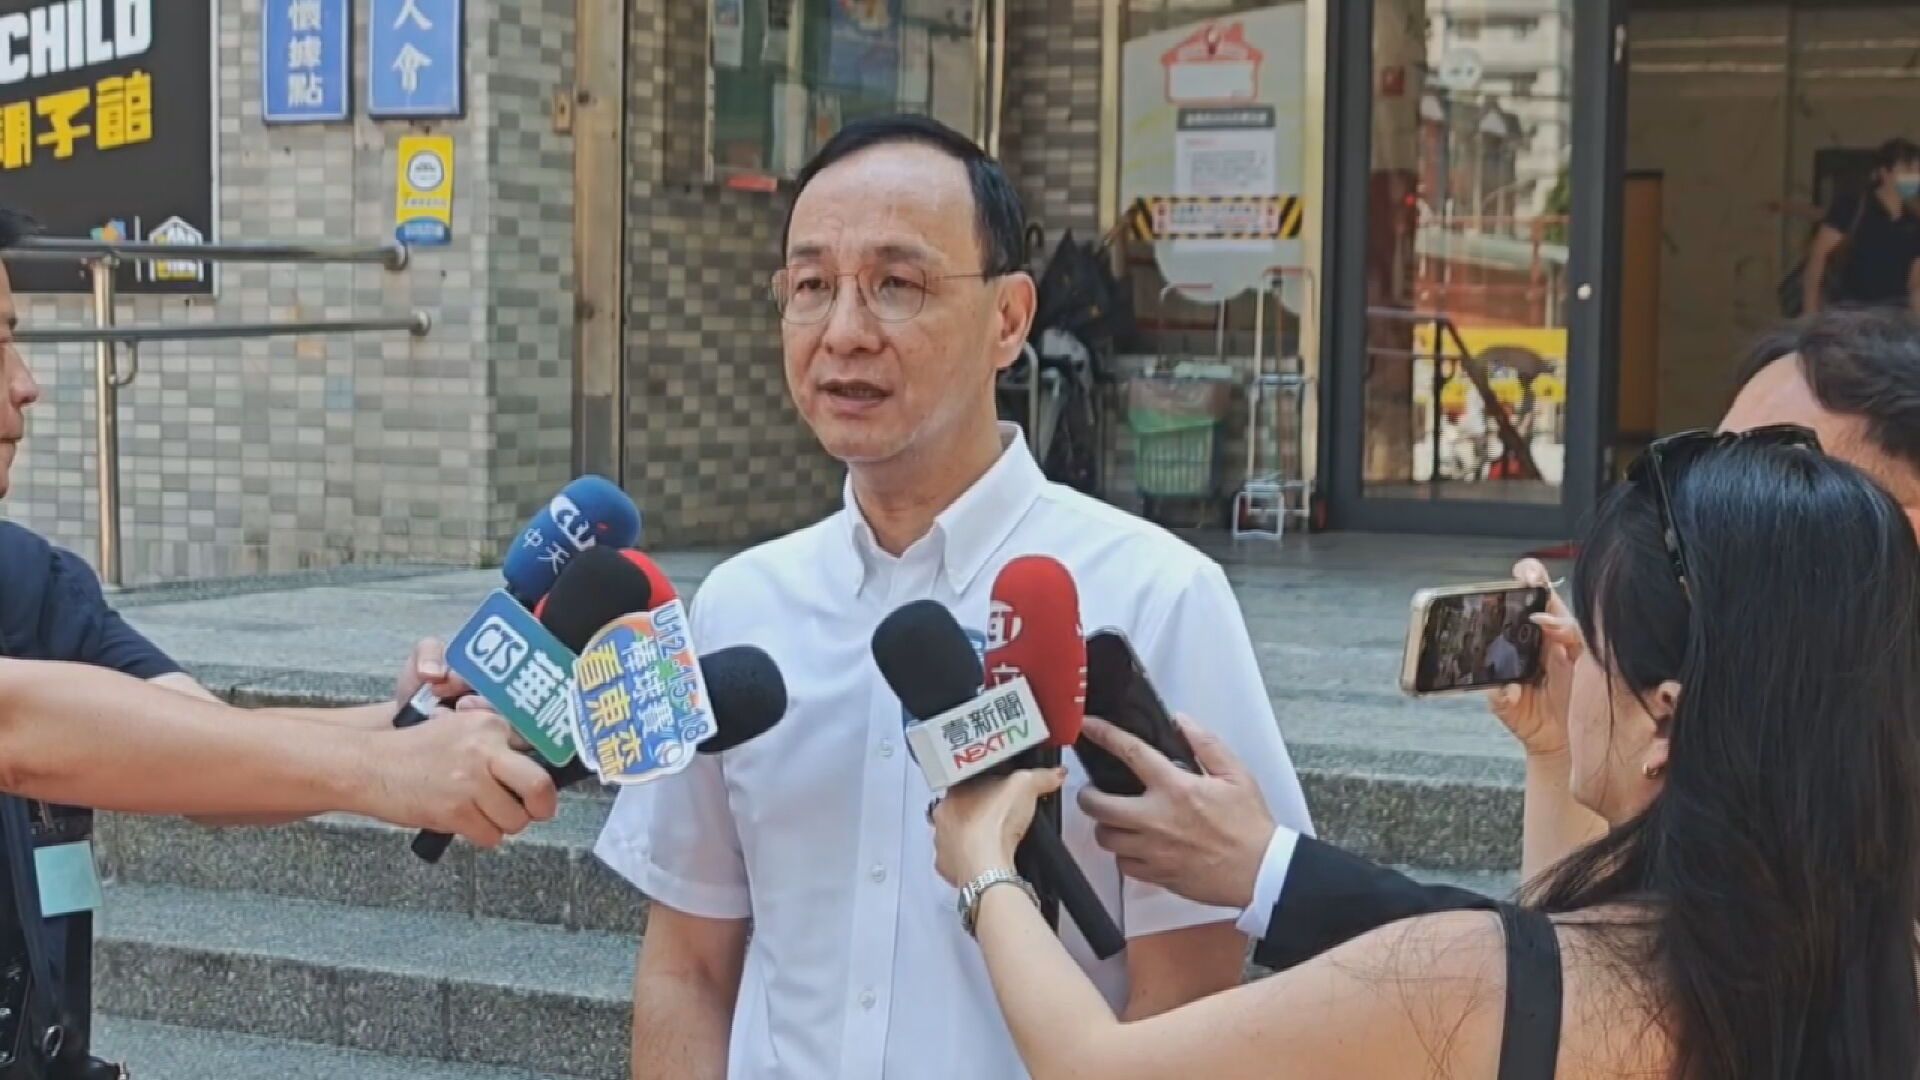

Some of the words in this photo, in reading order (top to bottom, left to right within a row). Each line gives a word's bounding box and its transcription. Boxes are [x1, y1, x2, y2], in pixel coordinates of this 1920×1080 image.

[523, 527, 571, 576] 中天
[472, 623, 526, 675] CTS
[579, 640, 643, 779] 看東森
[621, 636, 676, 738] 棒球賽
[941, 690, 1026, 751] 壹新聞
